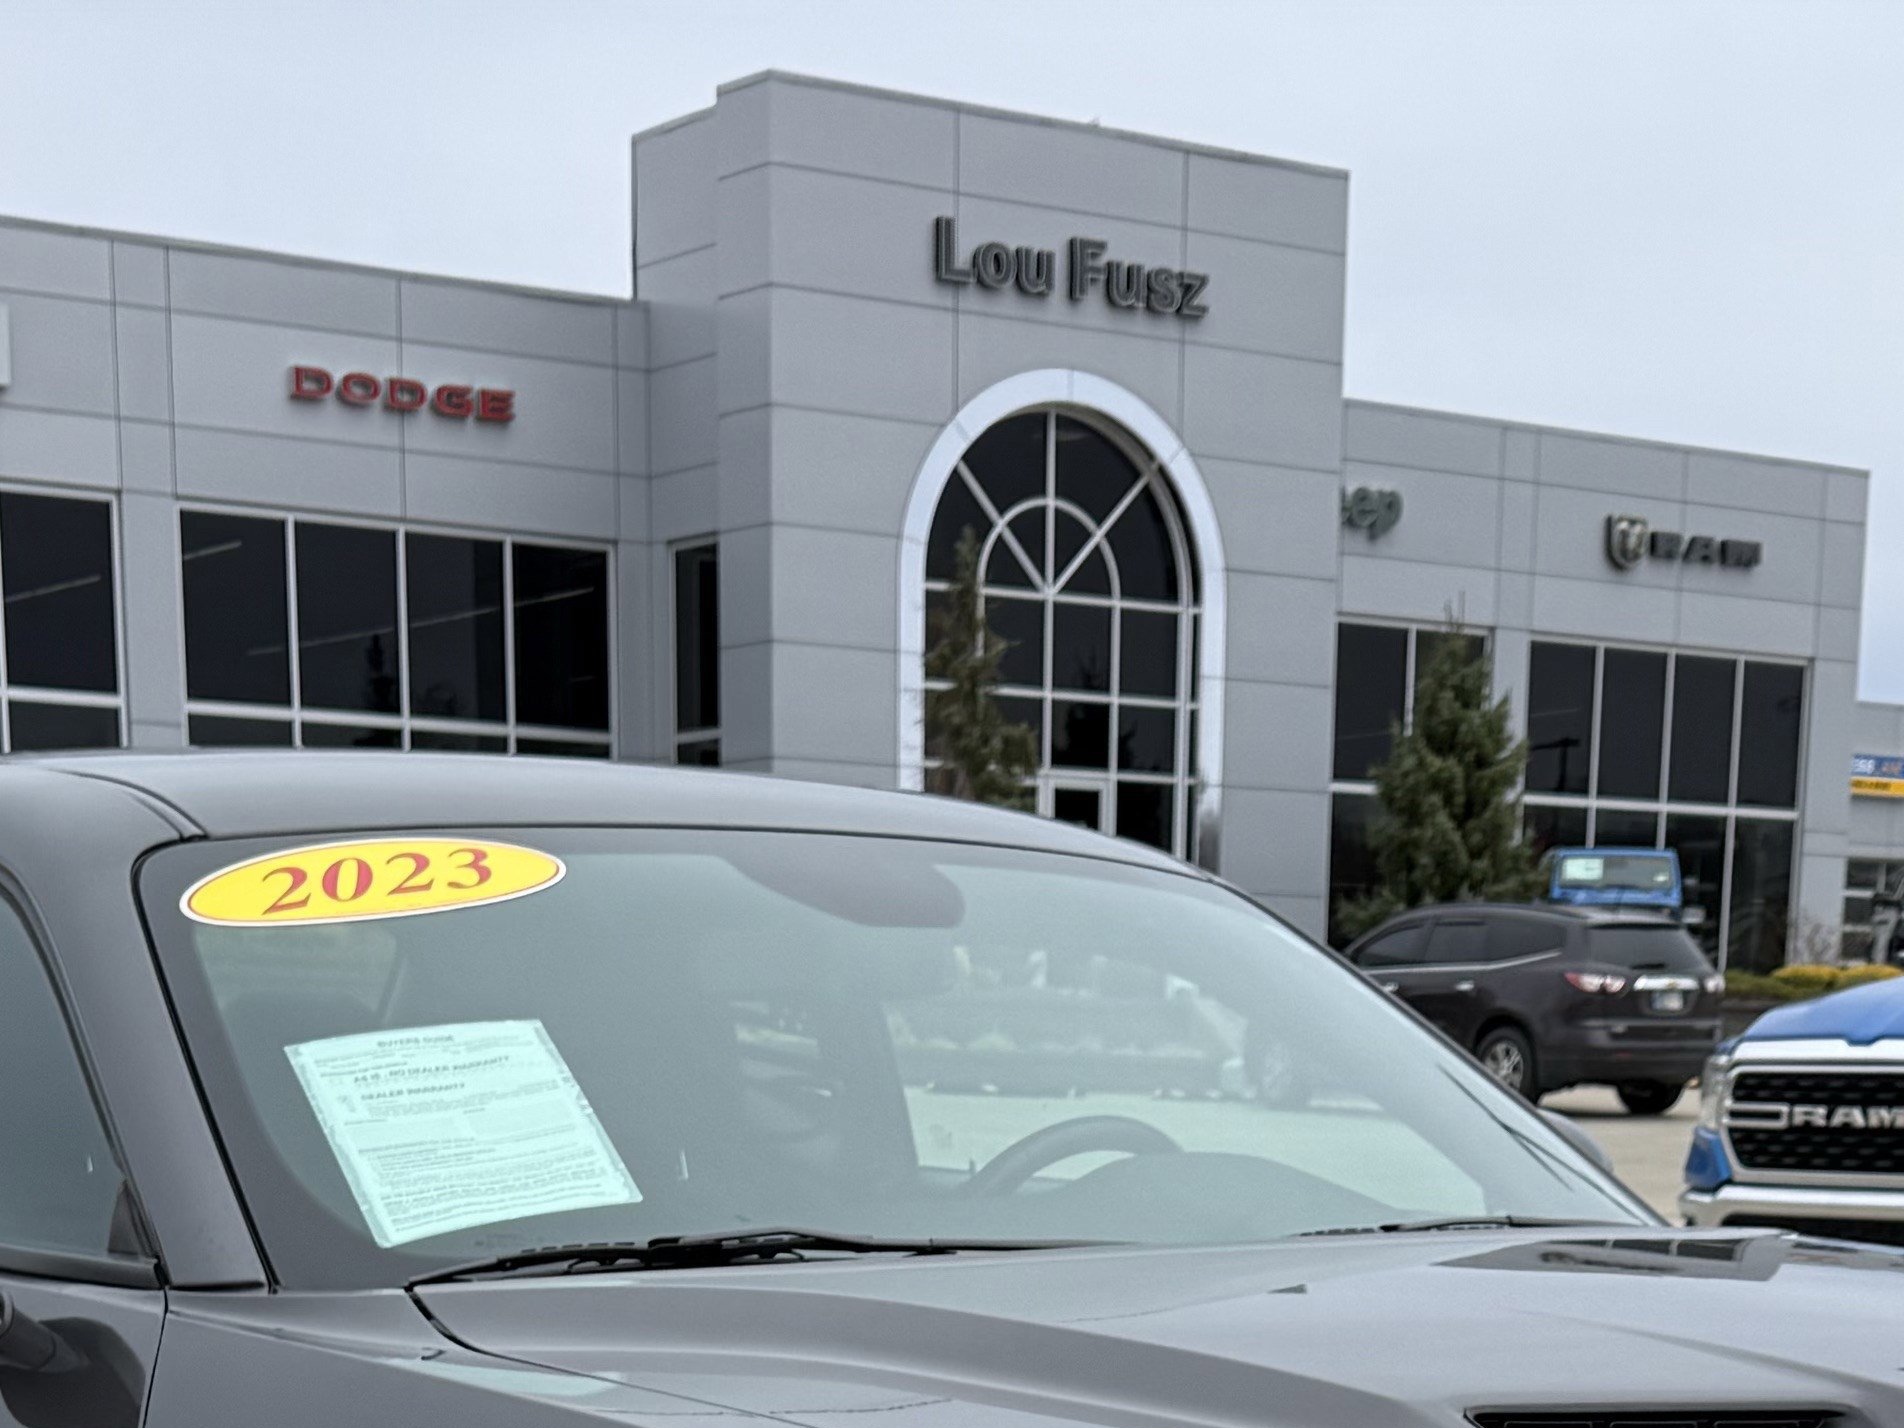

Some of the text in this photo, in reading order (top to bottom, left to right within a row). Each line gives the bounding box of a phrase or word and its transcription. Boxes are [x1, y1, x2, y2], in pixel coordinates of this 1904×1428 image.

[935, 215, 1209, 318] Lou Fusz
[290, 364, 516, 423] DODGE
[1649, 531, 1761, 567] RAM
[261, 847, 493, 915] 2023
